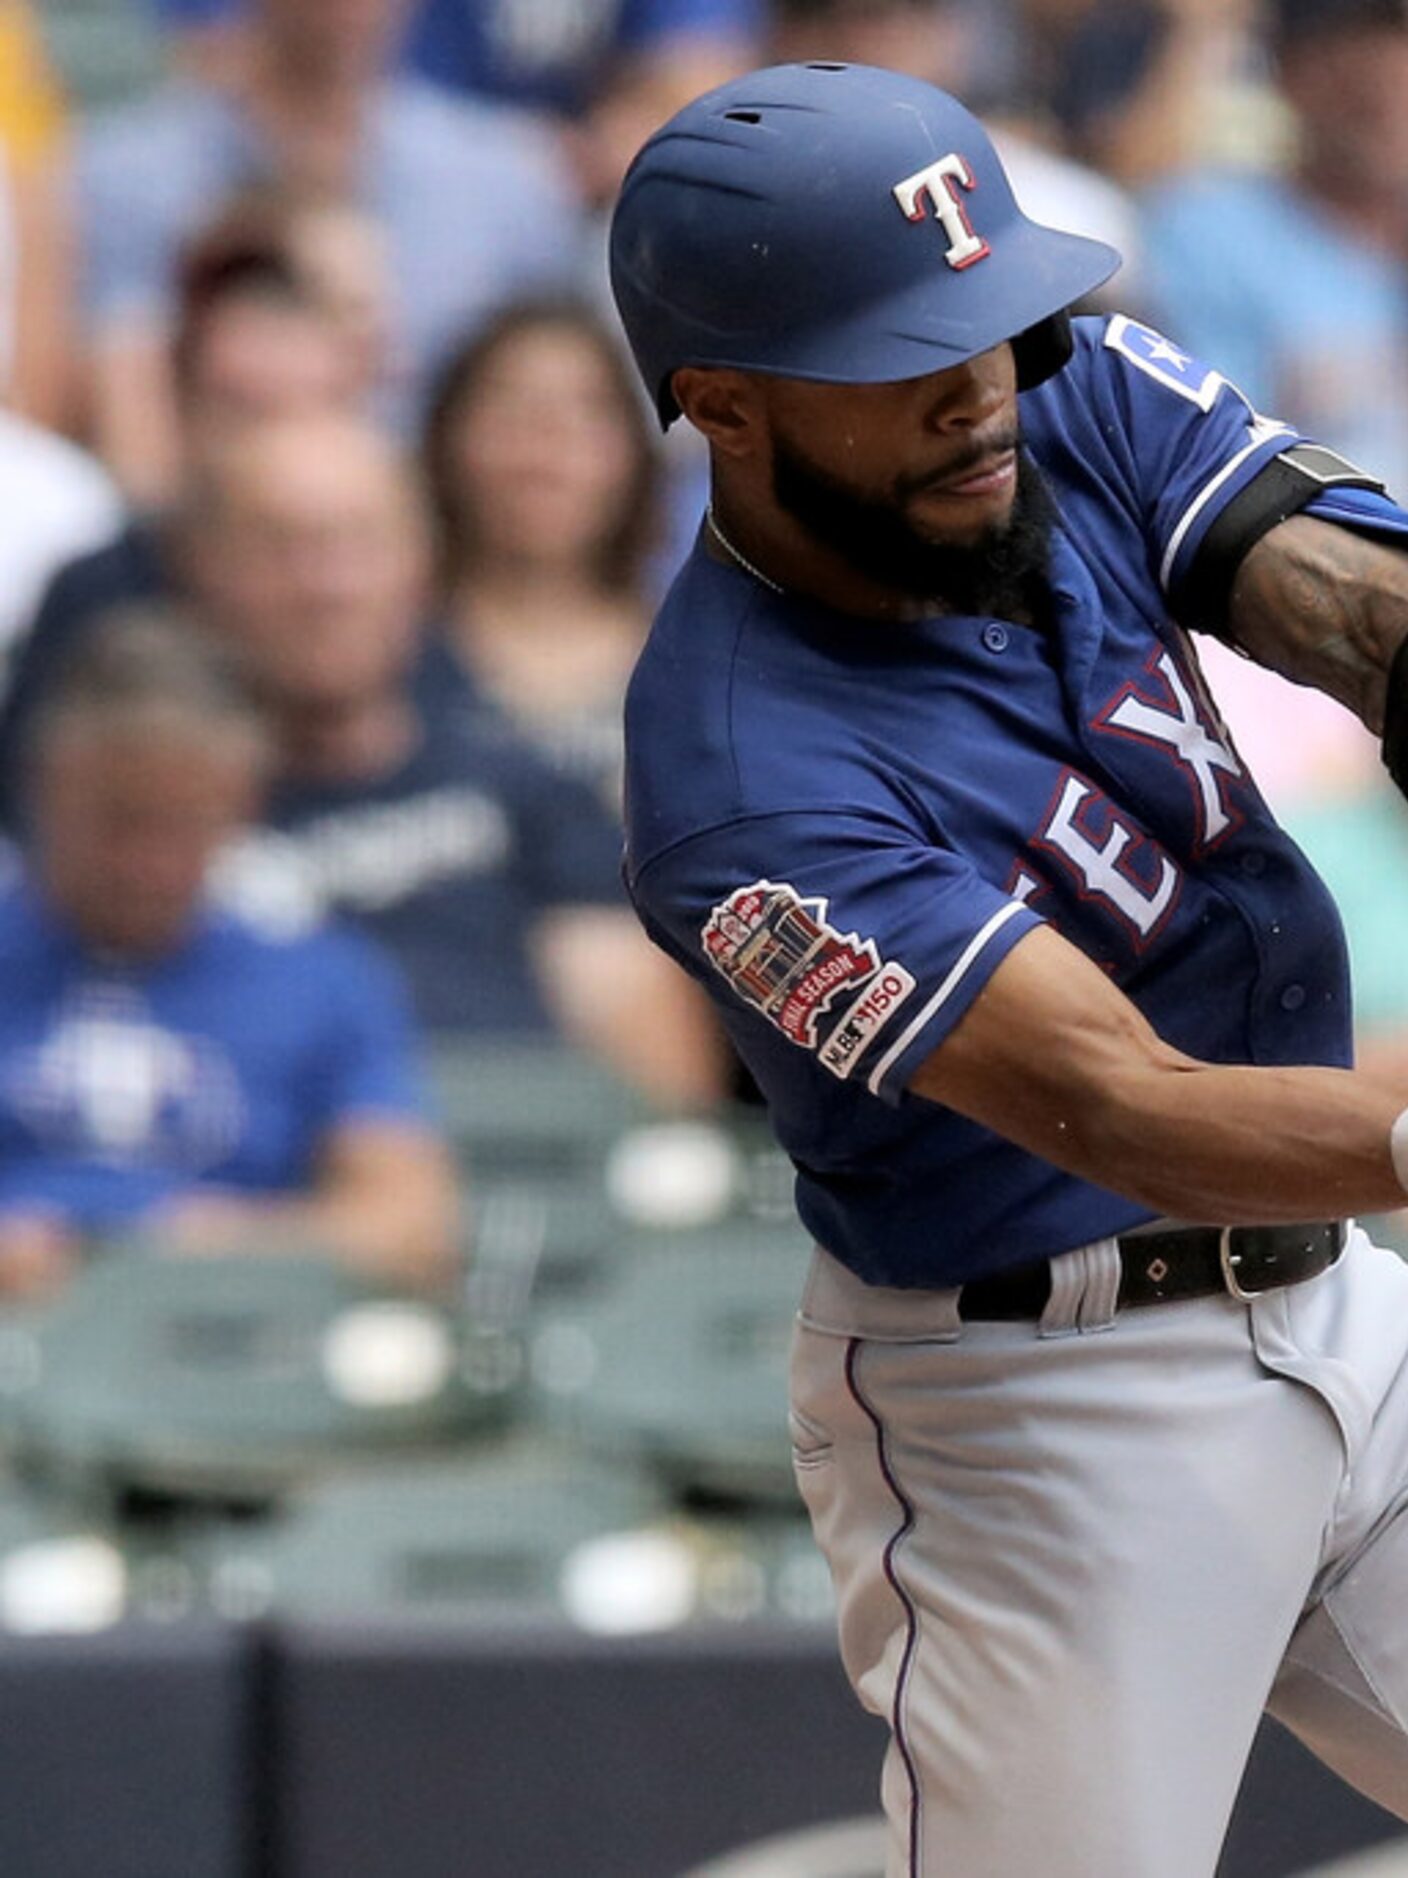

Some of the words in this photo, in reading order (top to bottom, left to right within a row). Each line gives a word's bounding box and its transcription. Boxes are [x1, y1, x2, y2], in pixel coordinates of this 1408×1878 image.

[891, 152, 991, 272] T
[1006, 646, 1247, 955] EX
[797, 953, 855, 1002] SEASON
[824, 1033, 856, 1071] MLB
[871, 975, 904, 1018] 150
